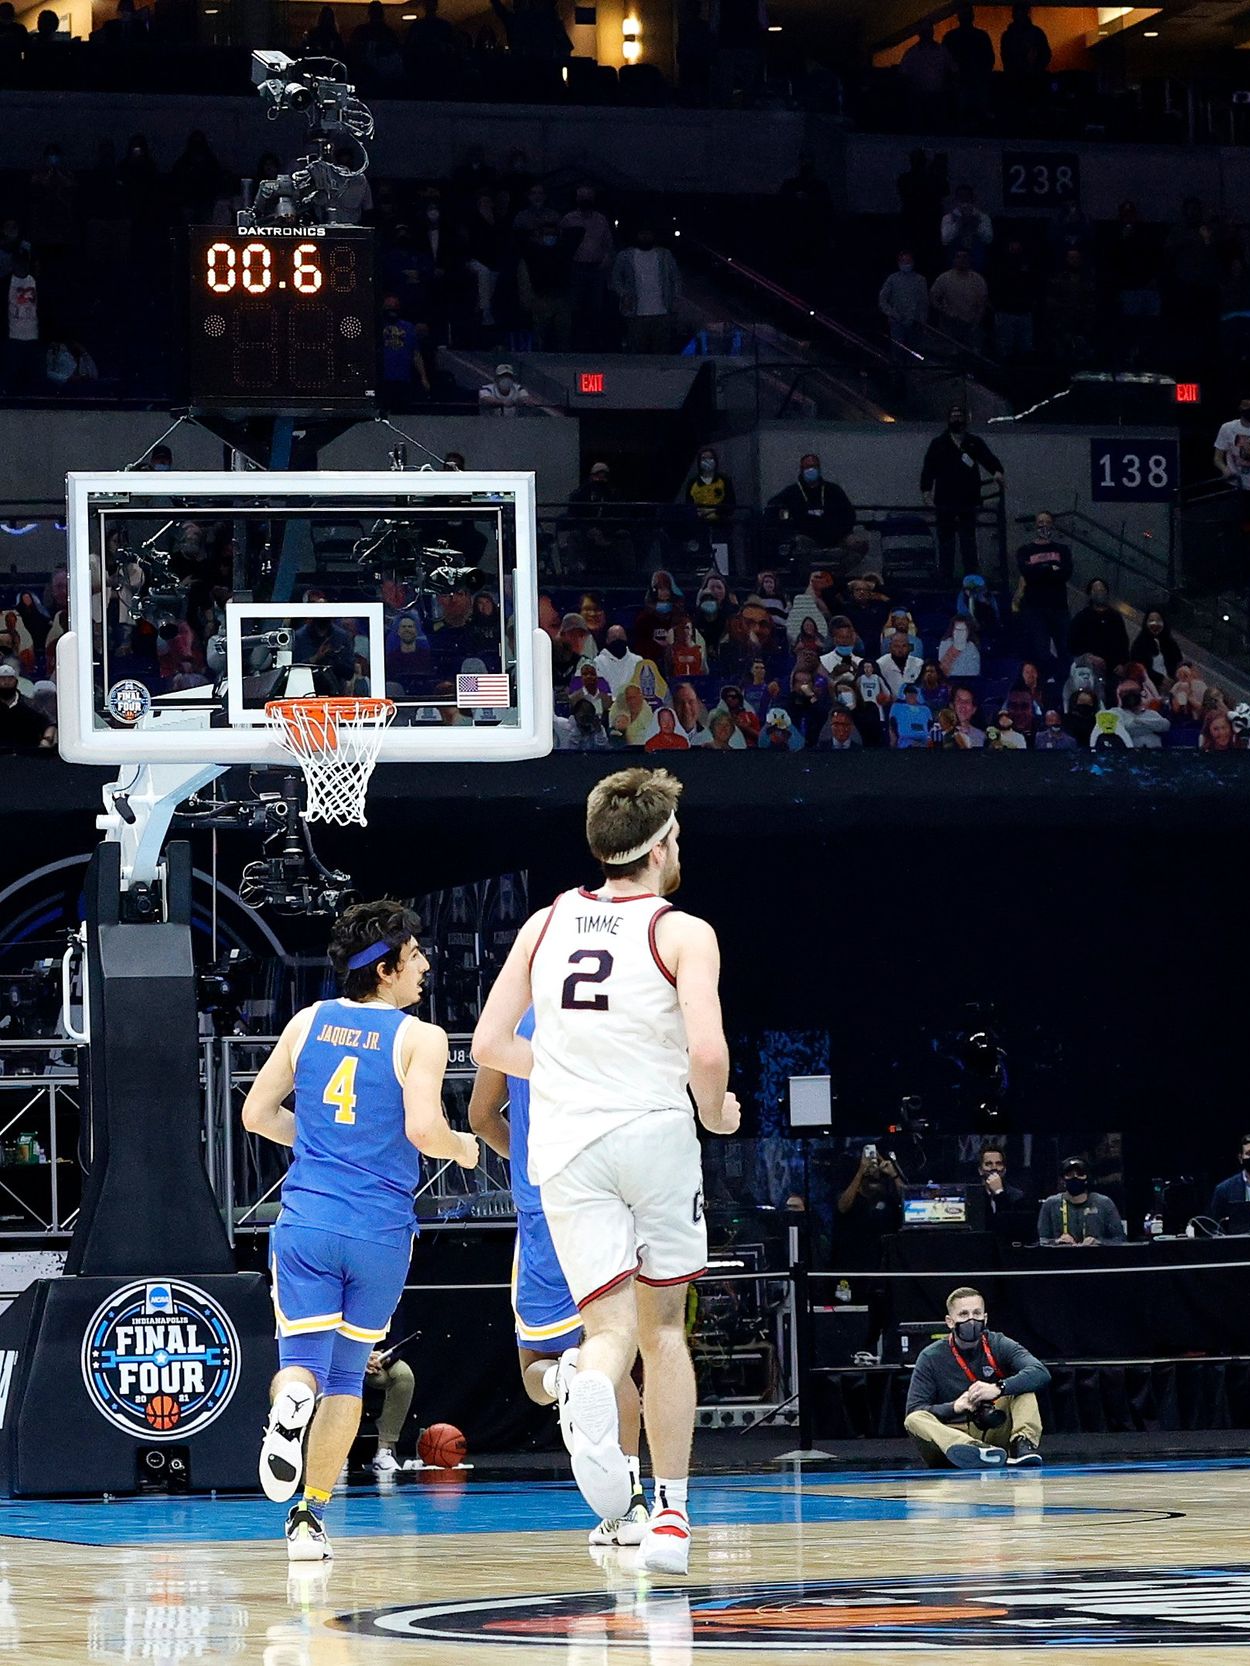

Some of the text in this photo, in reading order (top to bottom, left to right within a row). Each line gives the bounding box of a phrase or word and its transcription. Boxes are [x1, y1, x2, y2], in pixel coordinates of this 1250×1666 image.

[1008, 165, 1073, 195] 238
[238, 226, 326, 237] DAKTRONICS
[207, 242, 323, 294] 00.6
[581, 372, 603, 392] EXIT
[1176, 383, 1198, 401] EXIT
[1099, 453, 1169, 488] 138
[575, 915, 624, 935] TIMME
[561, 949, 614, 1011] 2
[317, 1024, 381, 1051] JAQUEZ JR.
[322, 1055, 359, 1125] 4
[132, 1317, 188, 1325] INDIANAPOLIS
[116, 1324, 206, 1355] FINAL
[118, 1361, 205, 1395] FOUR
